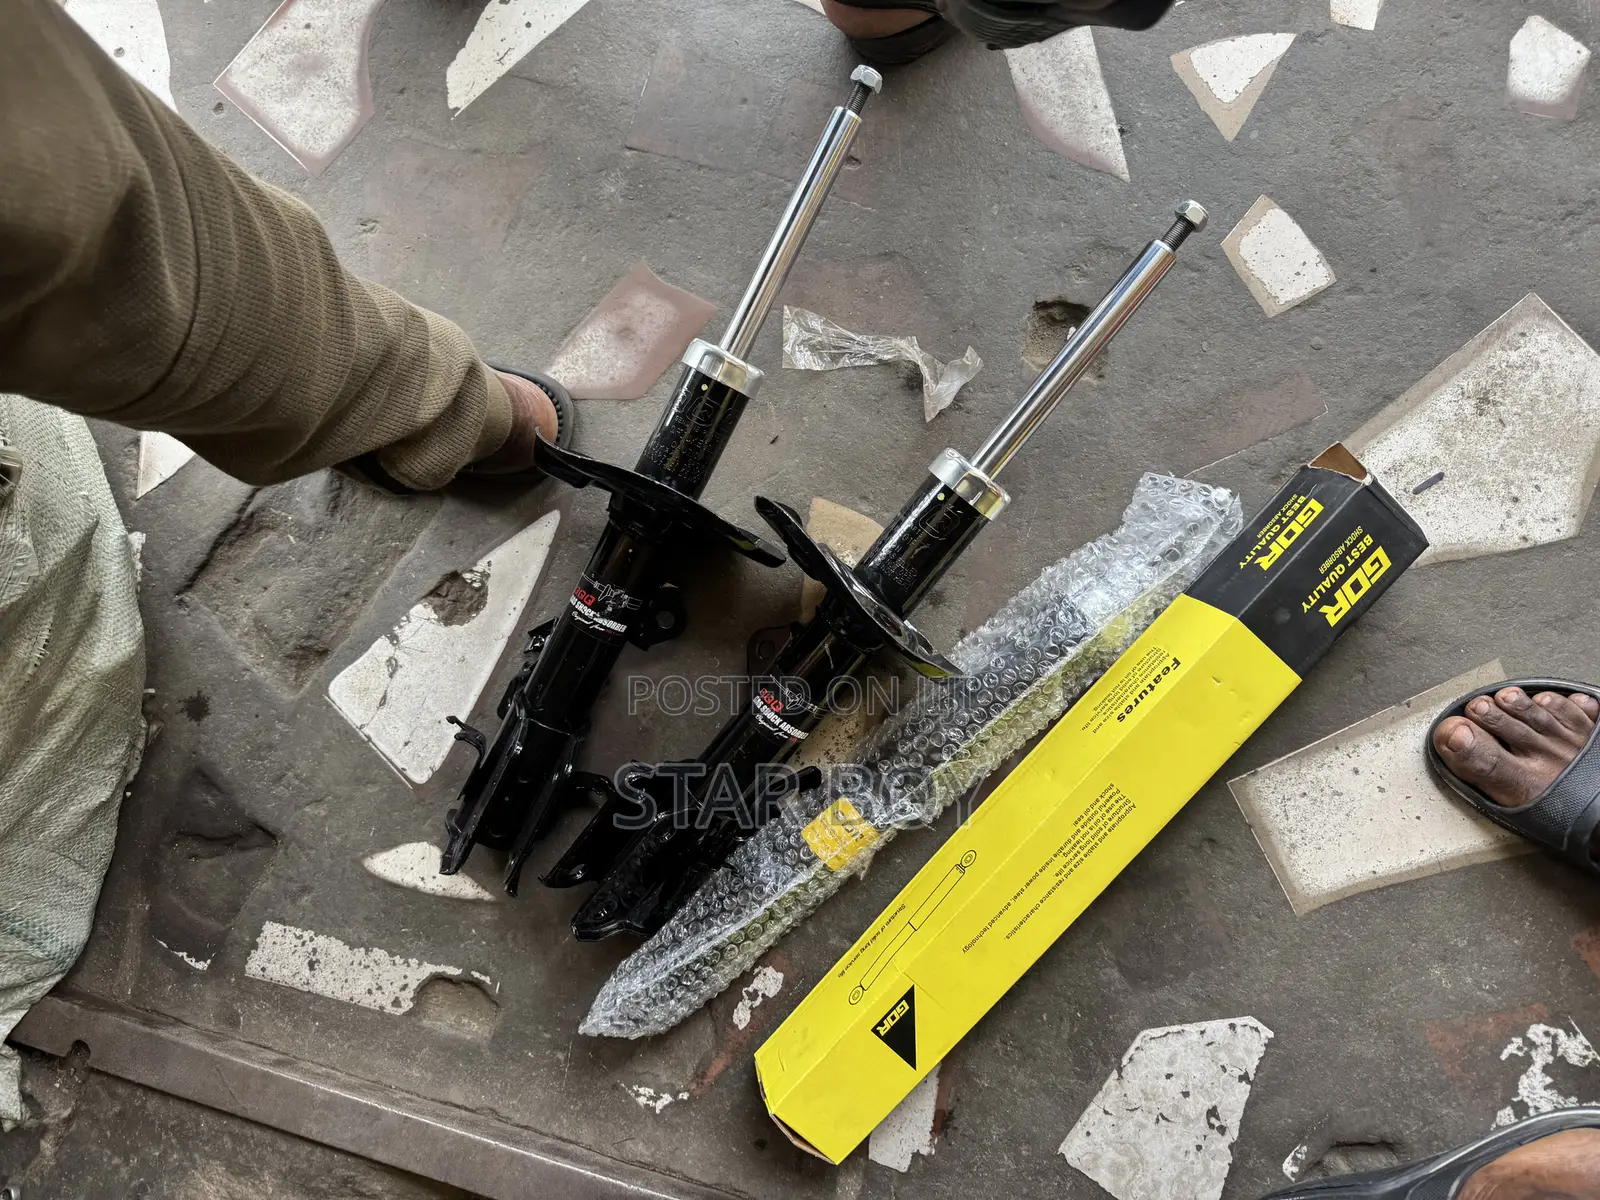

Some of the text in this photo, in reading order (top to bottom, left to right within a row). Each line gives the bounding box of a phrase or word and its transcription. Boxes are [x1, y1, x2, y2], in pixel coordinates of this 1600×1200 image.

[1258, 494, 1299, 538] SHOCK ABSORBER
[1239, 495, 1307, 568] BEST QUALITY
[1256, 499, 1324, 570] GOR
[1320, 527, 1363, 574] SHOCK ABSORBER
[1302, 534, 1374, 613] BEST QUALITY
[1320, 546, 1391, 627] GOR
[1106, 690, 1121, 704] long
[1116, 656, 1182, 723] Features
[1128, 683, 1141, 696] and
[1111, 693, 1131, 712] stable
[760, 704, 783, 726] SHOCK
[1102, 708, 1115, 723] size
[1091, 722, 1104, 735] and
[1097, 787, 1121, 813] Powerful
[1098, 782, 1115, 800] shock
[1113, 792, 1127, 805] The
[1082, 807, 1091, 817] oil
[1089, 797, 1101, 811] and
[1104, 802, 1116, 815] use
[1106, 797, 1132, 825] Structure
[1077, 807, 1100, 830] outside
[1092, 817, 1102, 828] oil
[1099, 812, 1109, 822] of
[1101, 820, 1109, 830] of
[1106, 802, 1137, 833] Appropriate
[1070, 827, 1082, 841] and
[1079, 829, 1091, 841] not
[1087, 824, 1097, 832] is
[1089, 824, 1104, 842] solid
[1078, 838, 1094, 852] long
[1097, 831, 1109, 844] and
[1052, 837, 1073, 859] durable
[1082, 841, 1100, 859] stable
[1037, 856, 1056, 874] inside
[1061, 849, 1082, 870] service
[1072, 856, 1085, 870] size
[1023, 870, 1040, 890] power
[1063, 867, 1075, 880] and
[1038, 876, 1065, 905] resistance
[987, 901, 1012, 929] advanced
[961, 925, 991, 955] technology
[877, 1000, 909, 1036] GOR
